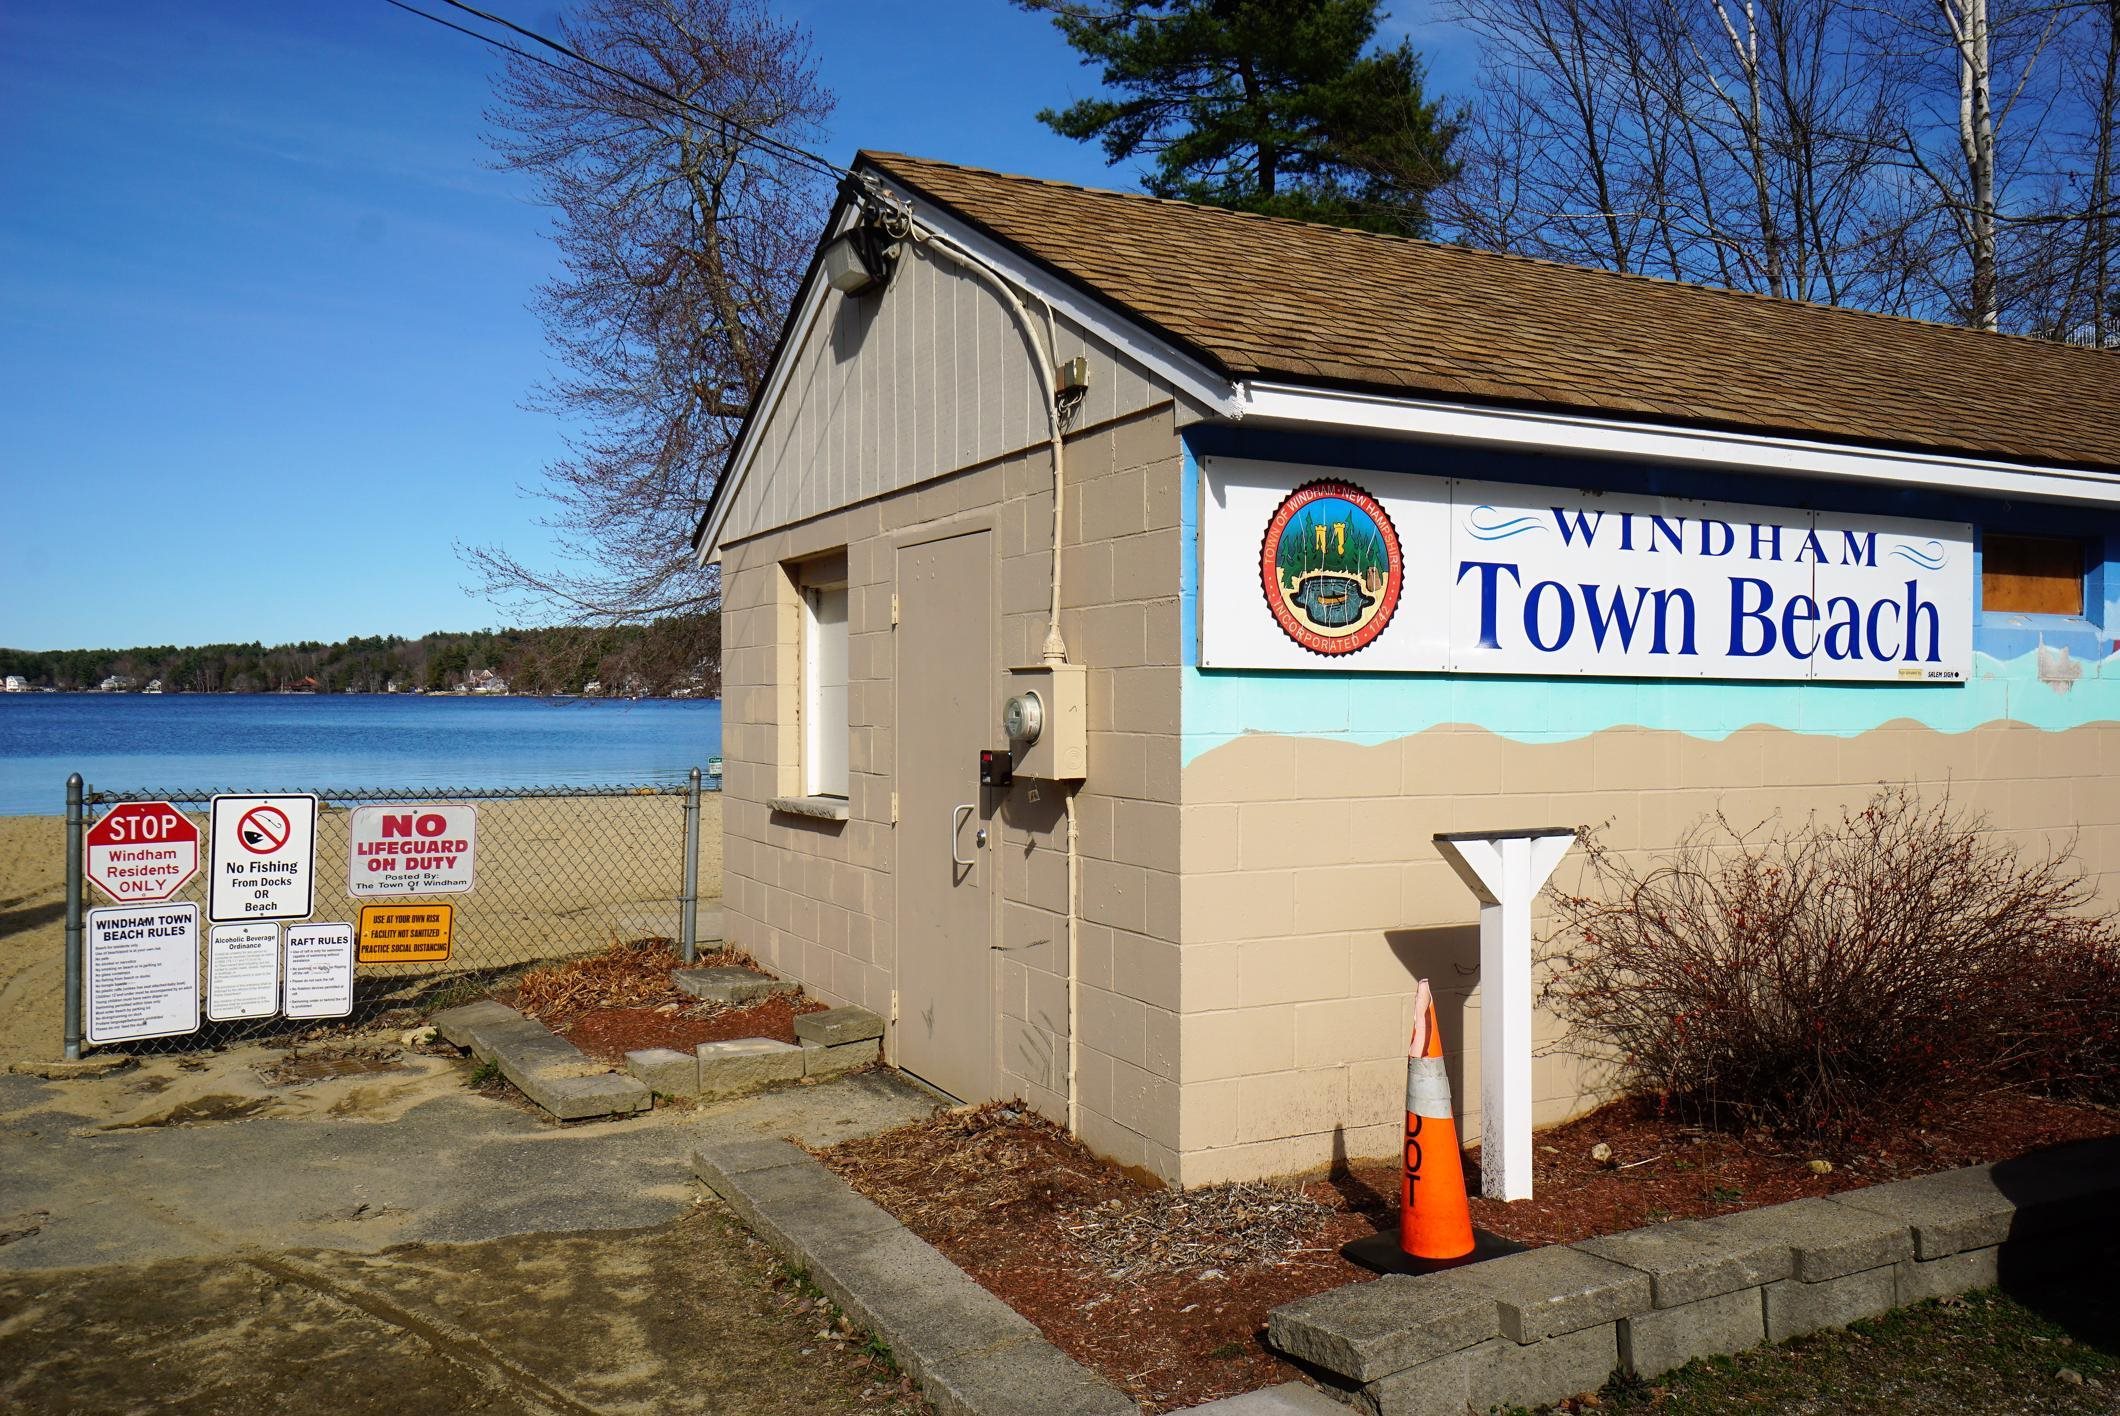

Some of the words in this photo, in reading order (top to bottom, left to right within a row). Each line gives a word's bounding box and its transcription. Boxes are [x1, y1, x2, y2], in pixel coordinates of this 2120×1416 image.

[1264, 527, 1282, 565] TOWN
[1277, 509, 1292, 527] OF
[1288, 485, 1336, 512] WINDHAM
[1341, 487, 1367, 505] NEW
[1366, 503, 1399, 572] HAMPSHIRE
[1550, 506, 1879, 568] WINDHAM
[1456, 560, 1699, 655] Town
[1725, 576, 1942, 664] Beach
[1273, 597, 1360, 651] INCORPORATED
[1368, 605, 1391, 633] 1742
[109, 814, 178, 841] STOP
[382, 813, 447, 838] NO
[357, 840, 469, 855] LIFEGUARD
[109, 849, 177, 862] Windham
[107, 864, 180, 878] Residents
[226, 862, 244, 874] No
[250, 860, 298, 874] Fishing
[367, 858, 396, 872] ON
[405, 856, 458, 870] DUTY
[232, 878, 258, 888] From
[261, 877, 292, 887] Docks
[385, 873, 420, 881] Posted
[119, 879, 167, 893] ONLY
[356, 882, 374, 890] The
[379, 881, 403, 889] Town
[408, 880, 419, 888] Of
[424, 879, 467, 887] Windham
[254, 889, 269, 899] OR
[245, 901, 277, 912] Beach
[96, 916, 155, 930] WINDHAM
[158, 913, 192, 925] TOWN
[373, 915, 385, 924] USE
[387, 915, 394, 924] AT
[395, 915, 411, 924] YOUR
[412, 914, 425, 923] OWN
[426, 914, 440, 923] RISK
[103, 929, 144, 941] BEACH
[148, 926, 186, 938] RULES
[371, 929, 397, 939] FACILITY
[398, 929, 410, 938] NOT
[410, 928, 440, 938] SANITIZED
[290, 937, 315, 946] RAFT
[318, 936, 349, 945] RULES
[361, 944, 390, 954] PRACTICE
[391, 943, 412, 953] SOCIAL
[414, 943, 447, 953] DISTANCING
[1405, 1110, 1423, 1208] DOT
